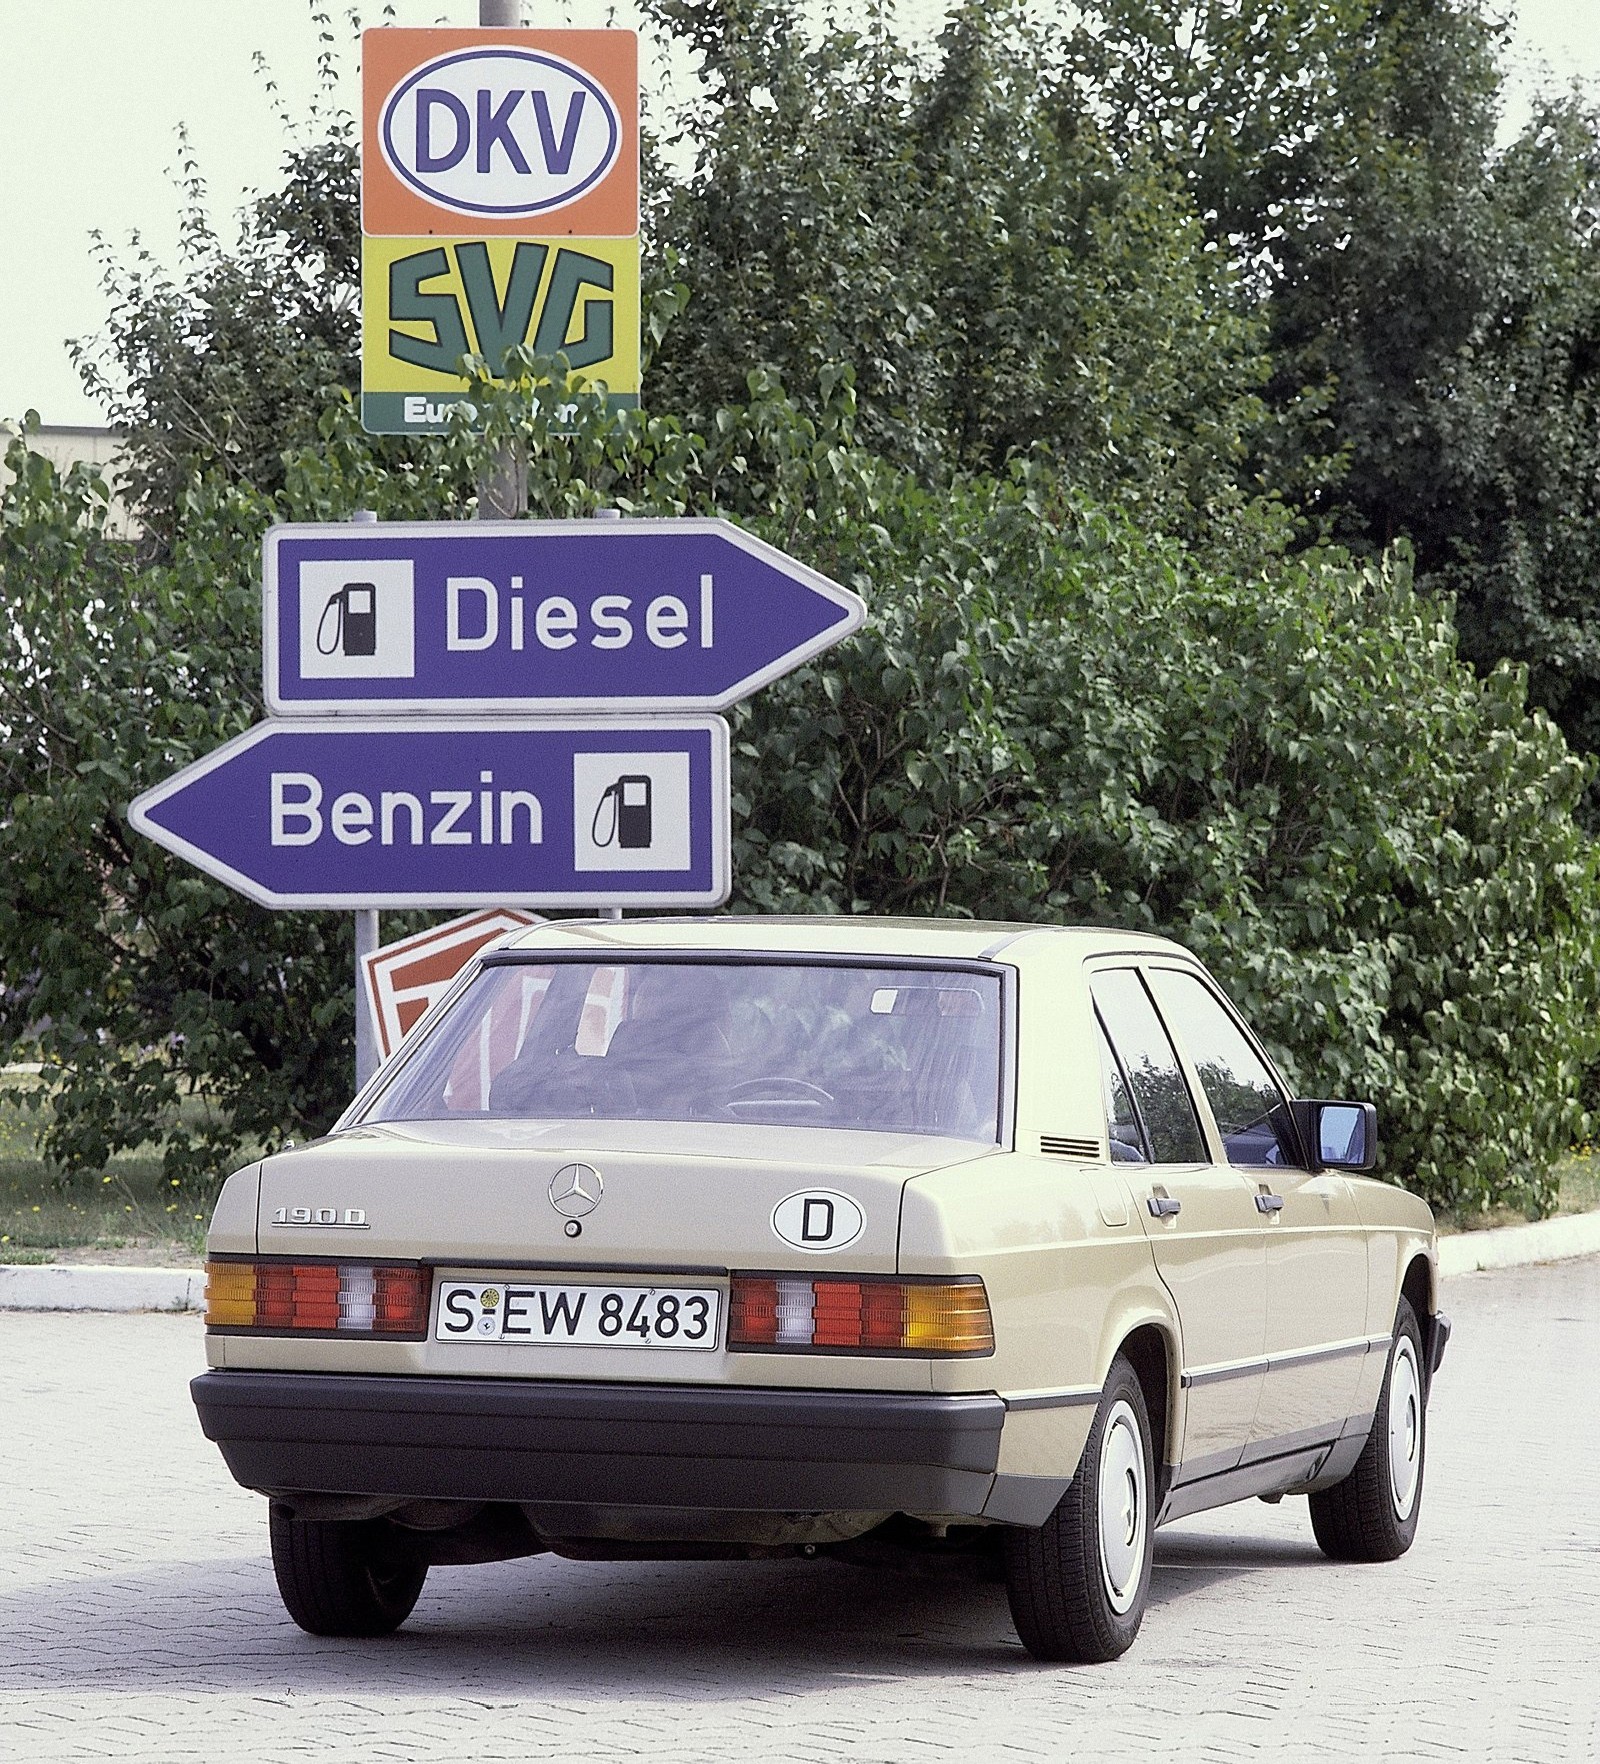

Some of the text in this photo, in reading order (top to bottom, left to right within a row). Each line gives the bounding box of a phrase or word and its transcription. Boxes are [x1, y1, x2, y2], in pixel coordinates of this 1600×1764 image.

[416, 89, 586, 174] DKV
[389, 241, 614, 380] SVG
[446, 575, 714, 651] Diesel
[270, 771, 543, 846] Benzin
[275, 1207, 366, 1225] 190 D
[802, 1198, 834, 1241] D
[599, 1293, 710, 1340] 8483
